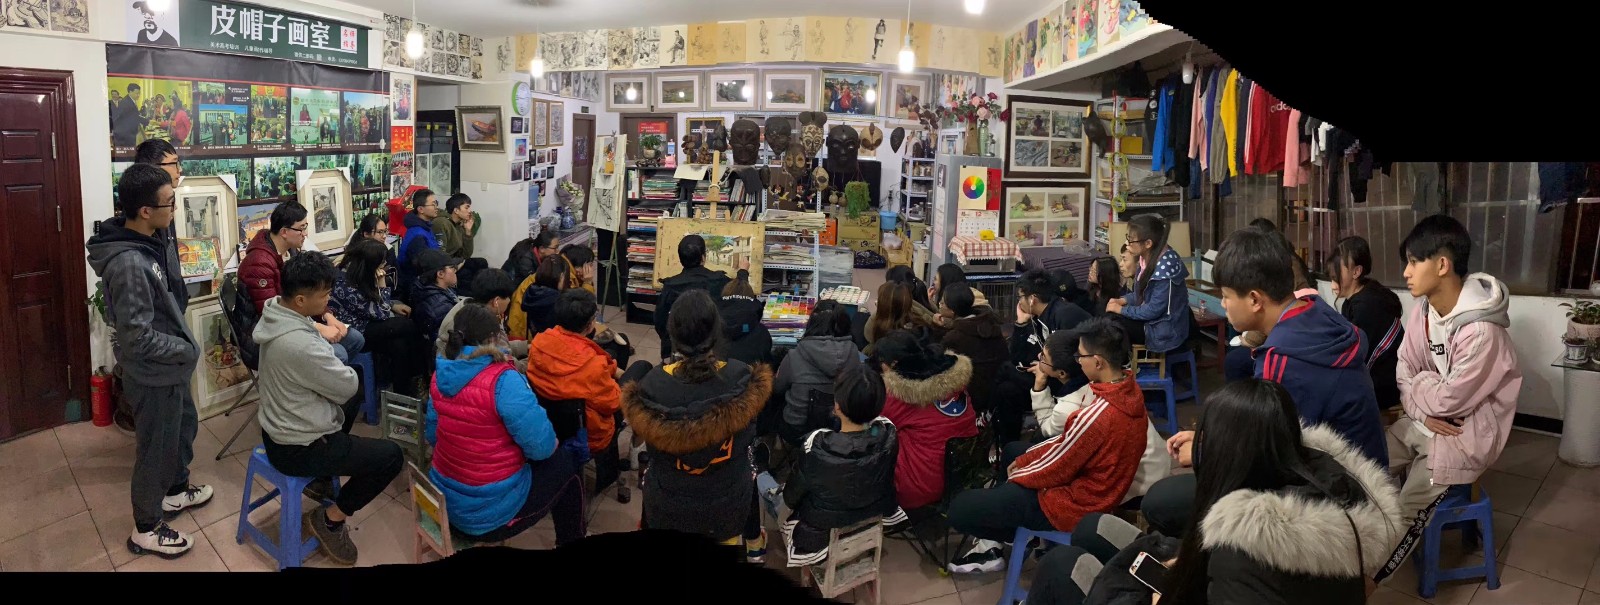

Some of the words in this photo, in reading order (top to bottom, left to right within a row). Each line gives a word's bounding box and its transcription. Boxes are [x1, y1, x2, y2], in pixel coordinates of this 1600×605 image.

[210, 5, 330, 48] 皮帽子画室
